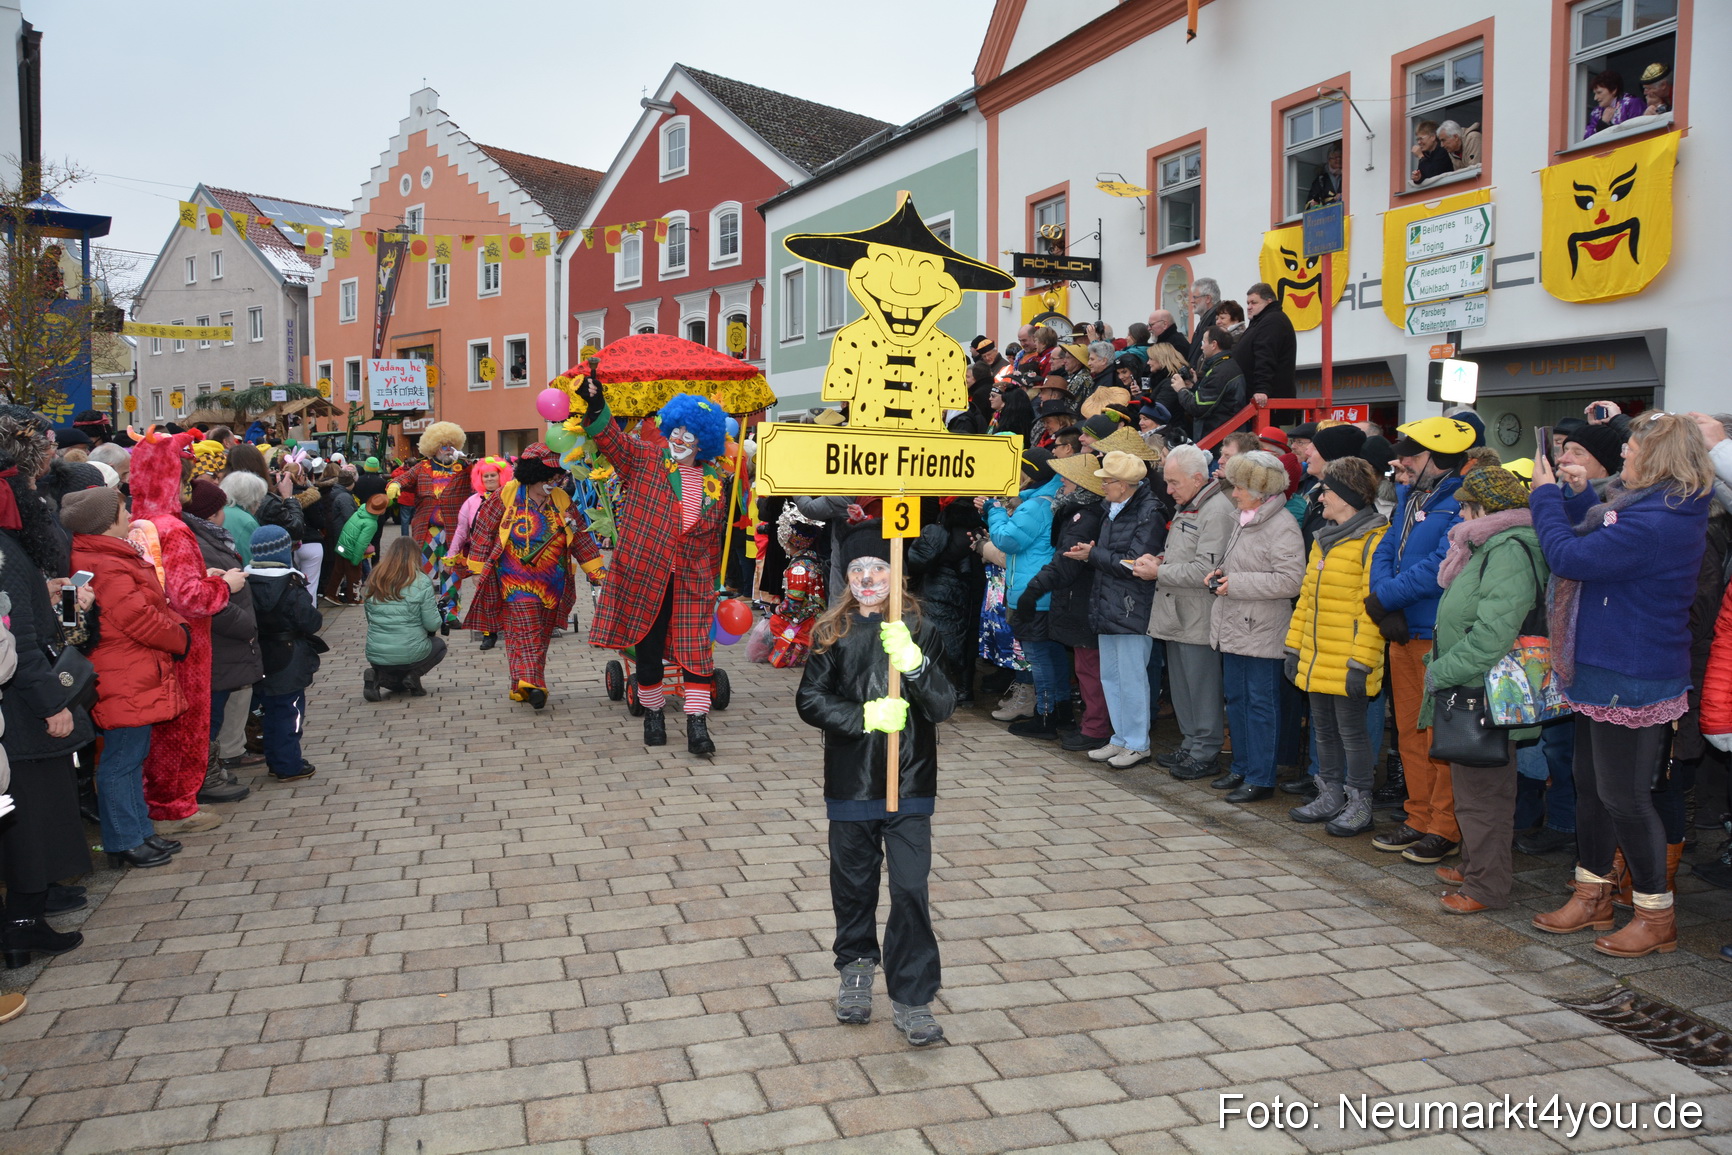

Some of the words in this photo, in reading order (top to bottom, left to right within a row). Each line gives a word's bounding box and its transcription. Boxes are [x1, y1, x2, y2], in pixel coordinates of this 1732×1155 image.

[1422, 220, 1456, 235] Beilngries
[1422, 241, 1444, 253] Töging
[1022, 257, 1093, 272] RÖHLICH
[1420, 264, 1457, 278] Riedenburg
[1420, 282, 1449, 296] Mühlbach
[1420, 306, 1447, 318] Parsberg
[1420, 319, 1457, 331] Breitenbrunn
[1530, 354, 1616, 376] UHREN
[1298, 371, 1395, 393] TRURINGE
[825, 443, 889, 476] Biker
[897, 446, 976, 478] Friends
[894, 502, 910, 531] 3
